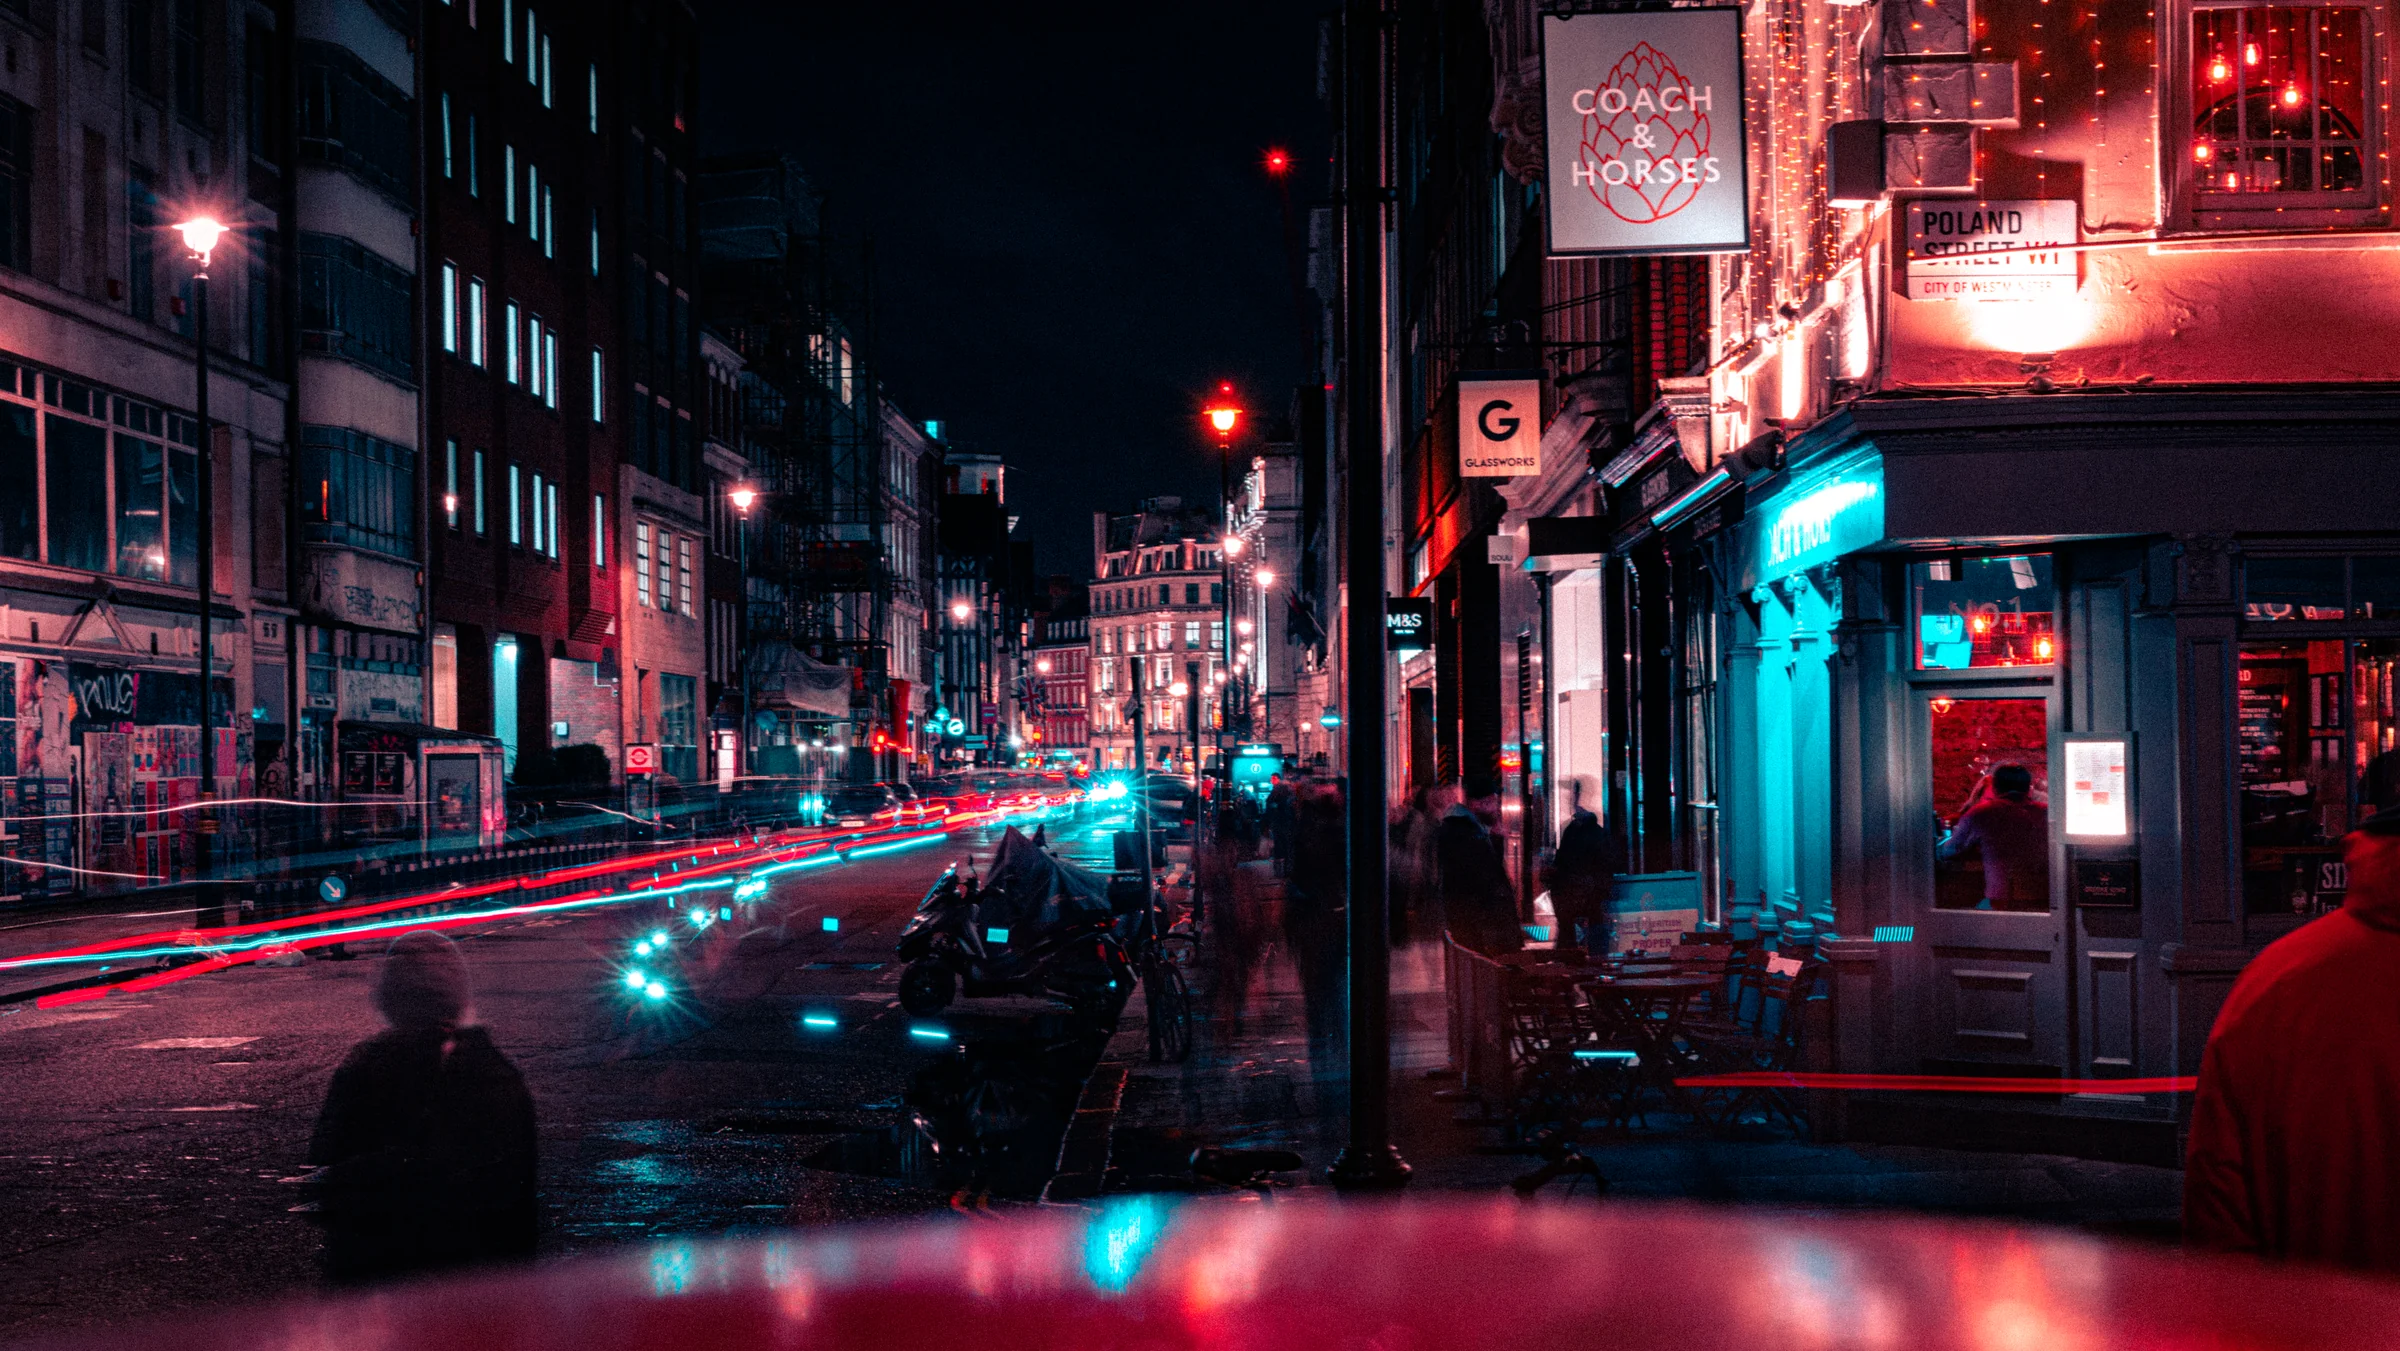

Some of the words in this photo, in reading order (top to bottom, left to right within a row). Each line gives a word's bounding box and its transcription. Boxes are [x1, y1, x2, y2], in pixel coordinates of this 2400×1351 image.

[1572, 86, 1712, 115] COACH
[1632, 123, 1656, 149] &
[1572, 157, 1721, 187] HORSES
[1923, 211, 2022, 235] POLAND
[1924, 282, 1950, 294] CITY
[1954, 282, 1967, 293] OF
[1478, 399, 1520, 442] G
[1465, 458, 1535, 467] GLASSWORKS
[1386, 613, 1422, 628] M&S
